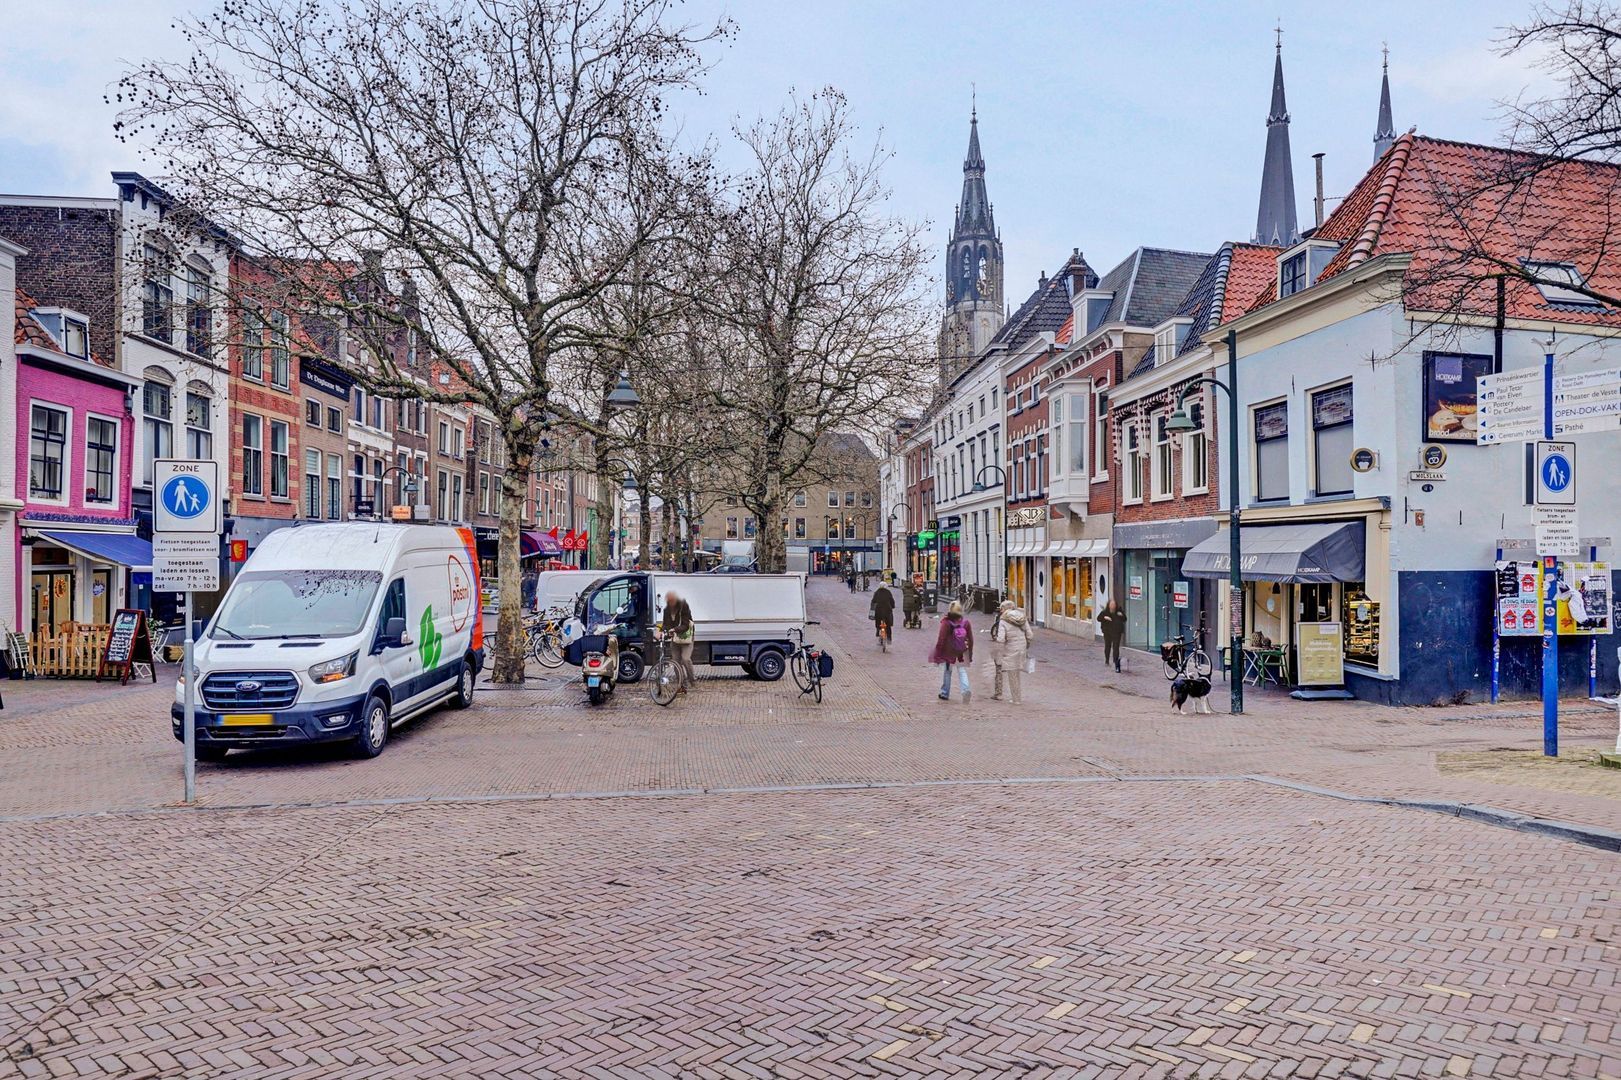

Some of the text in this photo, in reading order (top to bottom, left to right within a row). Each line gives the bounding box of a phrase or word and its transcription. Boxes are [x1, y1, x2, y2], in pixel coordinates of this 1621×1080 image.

[1496, 372, 1540, 383] Prinsenkwartier
[1504, 406, 1532, 414] Candelaer
[1554, 403, 1618, 418] OPEN-DOK-VAK
[1564, 422, 1584, 432] Pathé
[172, 464, 200, 473] ZONE
[1214, 555, 1258, 570] HOLAMP
